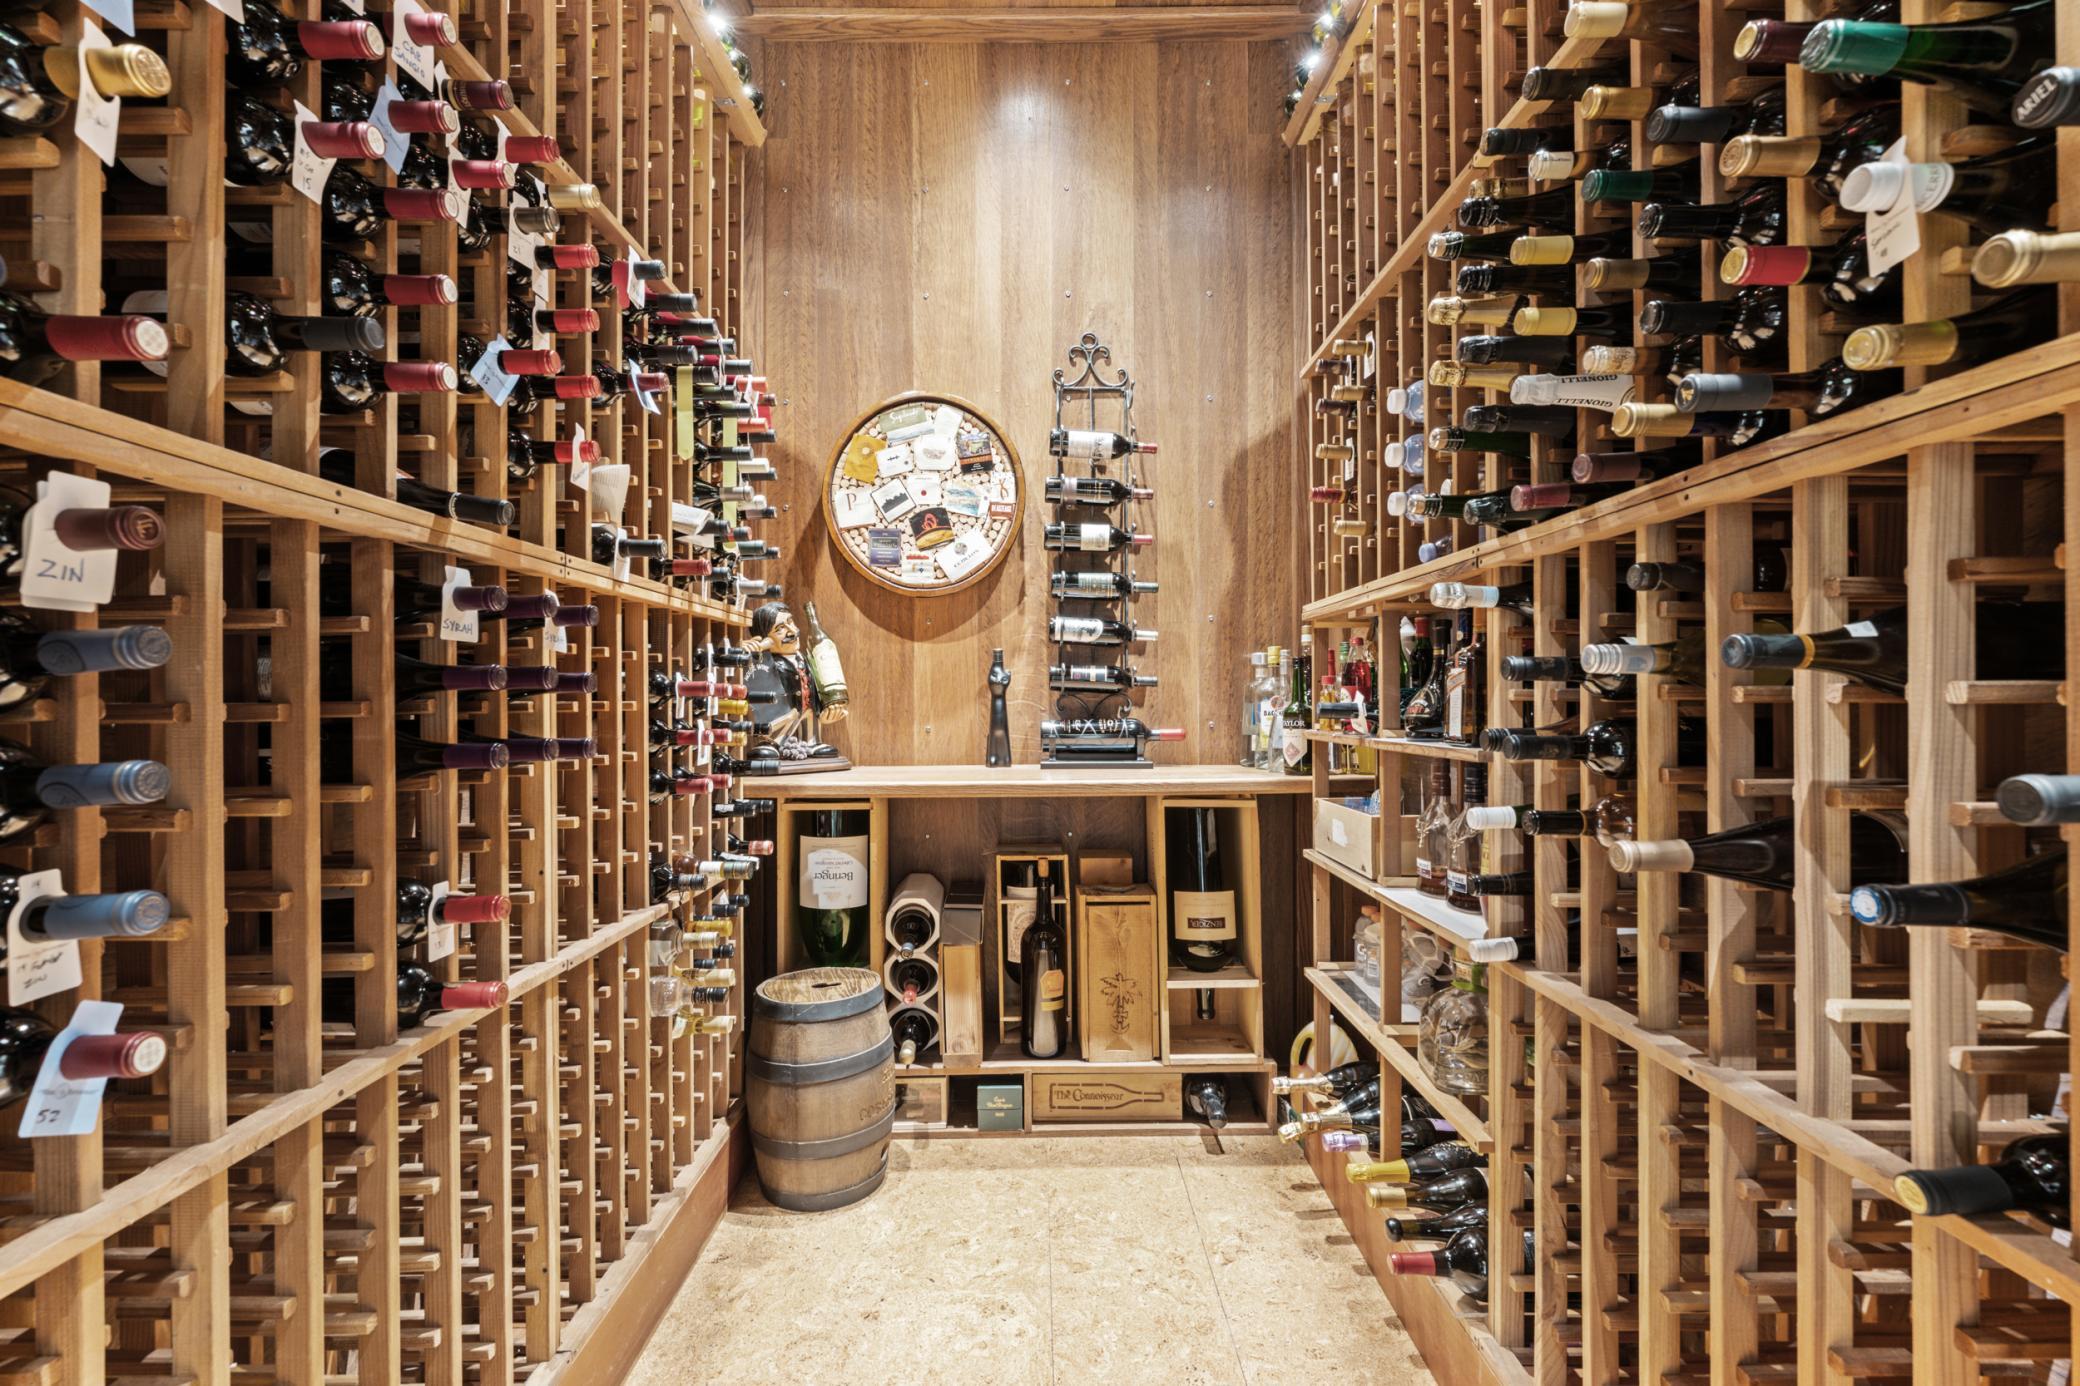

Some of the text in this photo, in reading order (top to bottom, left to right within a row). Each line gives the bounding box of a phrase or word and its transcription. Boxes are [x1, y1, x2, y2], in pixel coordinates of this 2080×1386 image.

[2016, 79, 2058, 121] ARIEL
[1561, 374, 1618, 384] GIONELLI
[1556, 398, 1613, 408] GIONELLI
[36, 557, 85, 583] ZIN
[442, 618, 473, 636] SYRAH
[1282, 720, 1305, 728] AYLOR
[814, 869, 854, 881] Beringer
[1056, 1088, 1125, 1102] The Connoisseur
[36, 1108, 61, 1125] 52
